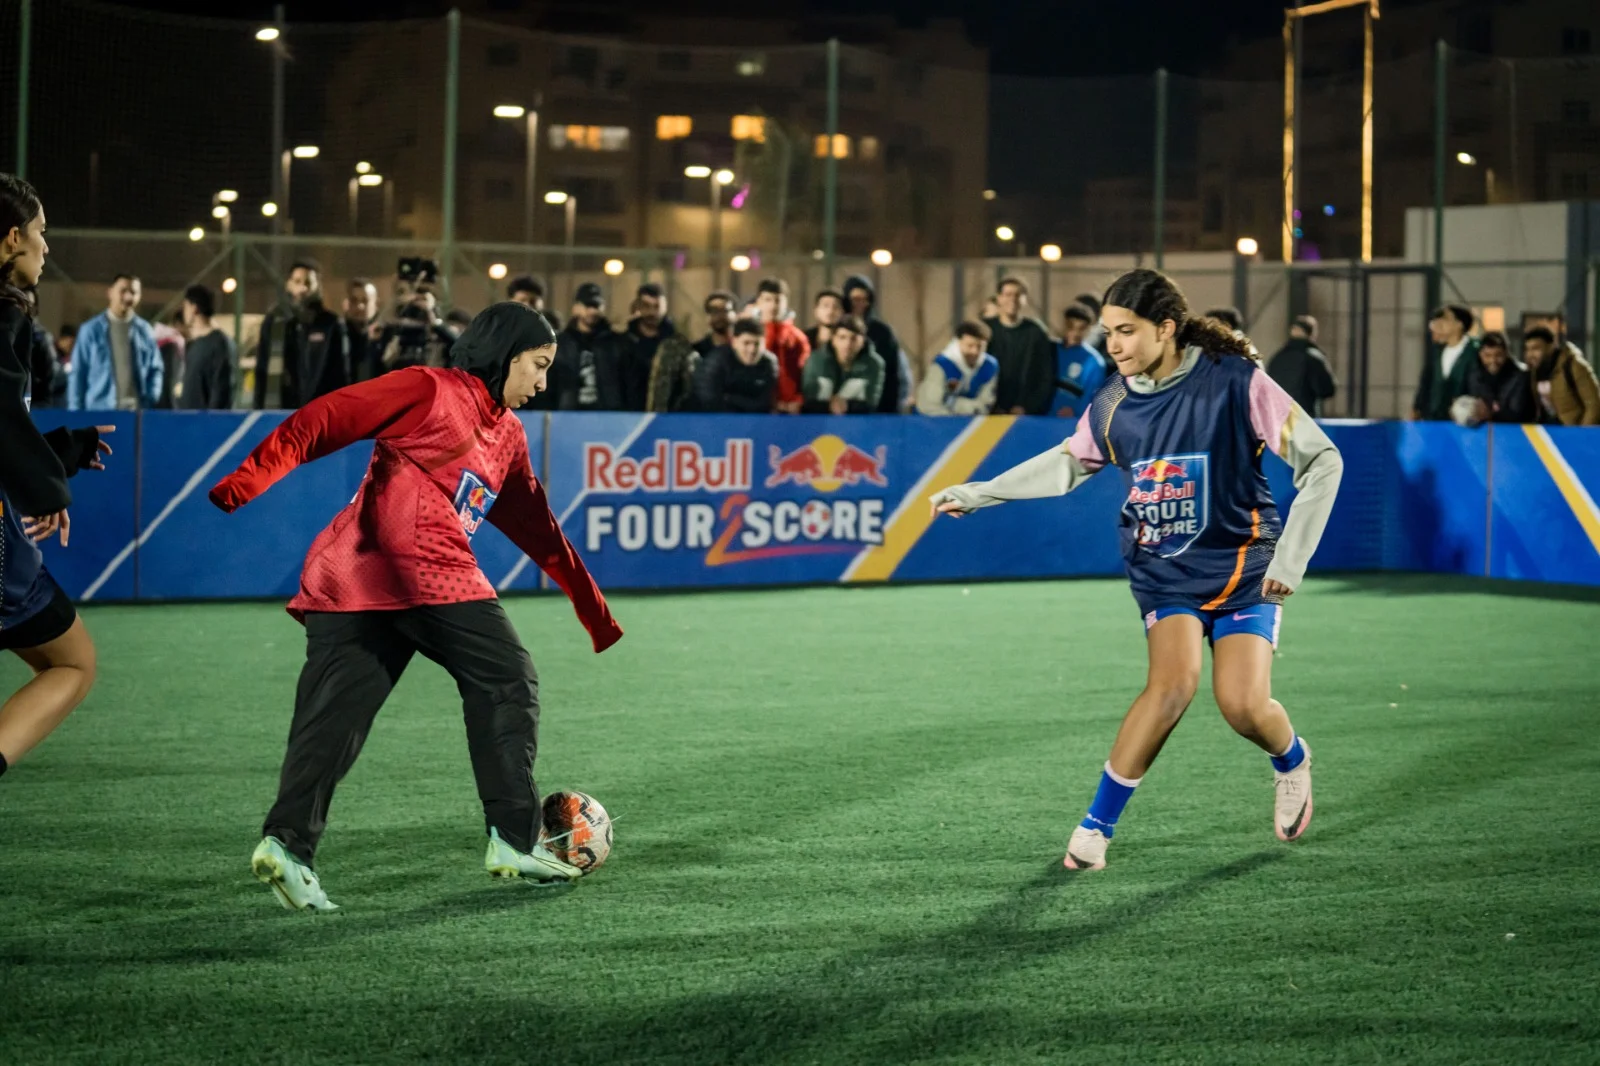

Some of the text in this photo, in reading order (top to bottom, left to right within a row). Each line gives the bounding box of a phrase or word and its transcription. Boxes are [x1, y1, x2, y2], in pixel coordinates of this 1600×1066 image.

[583, 438, 753, 492] Red Bull
[1129, 481, 1195, 504] Red Bull
